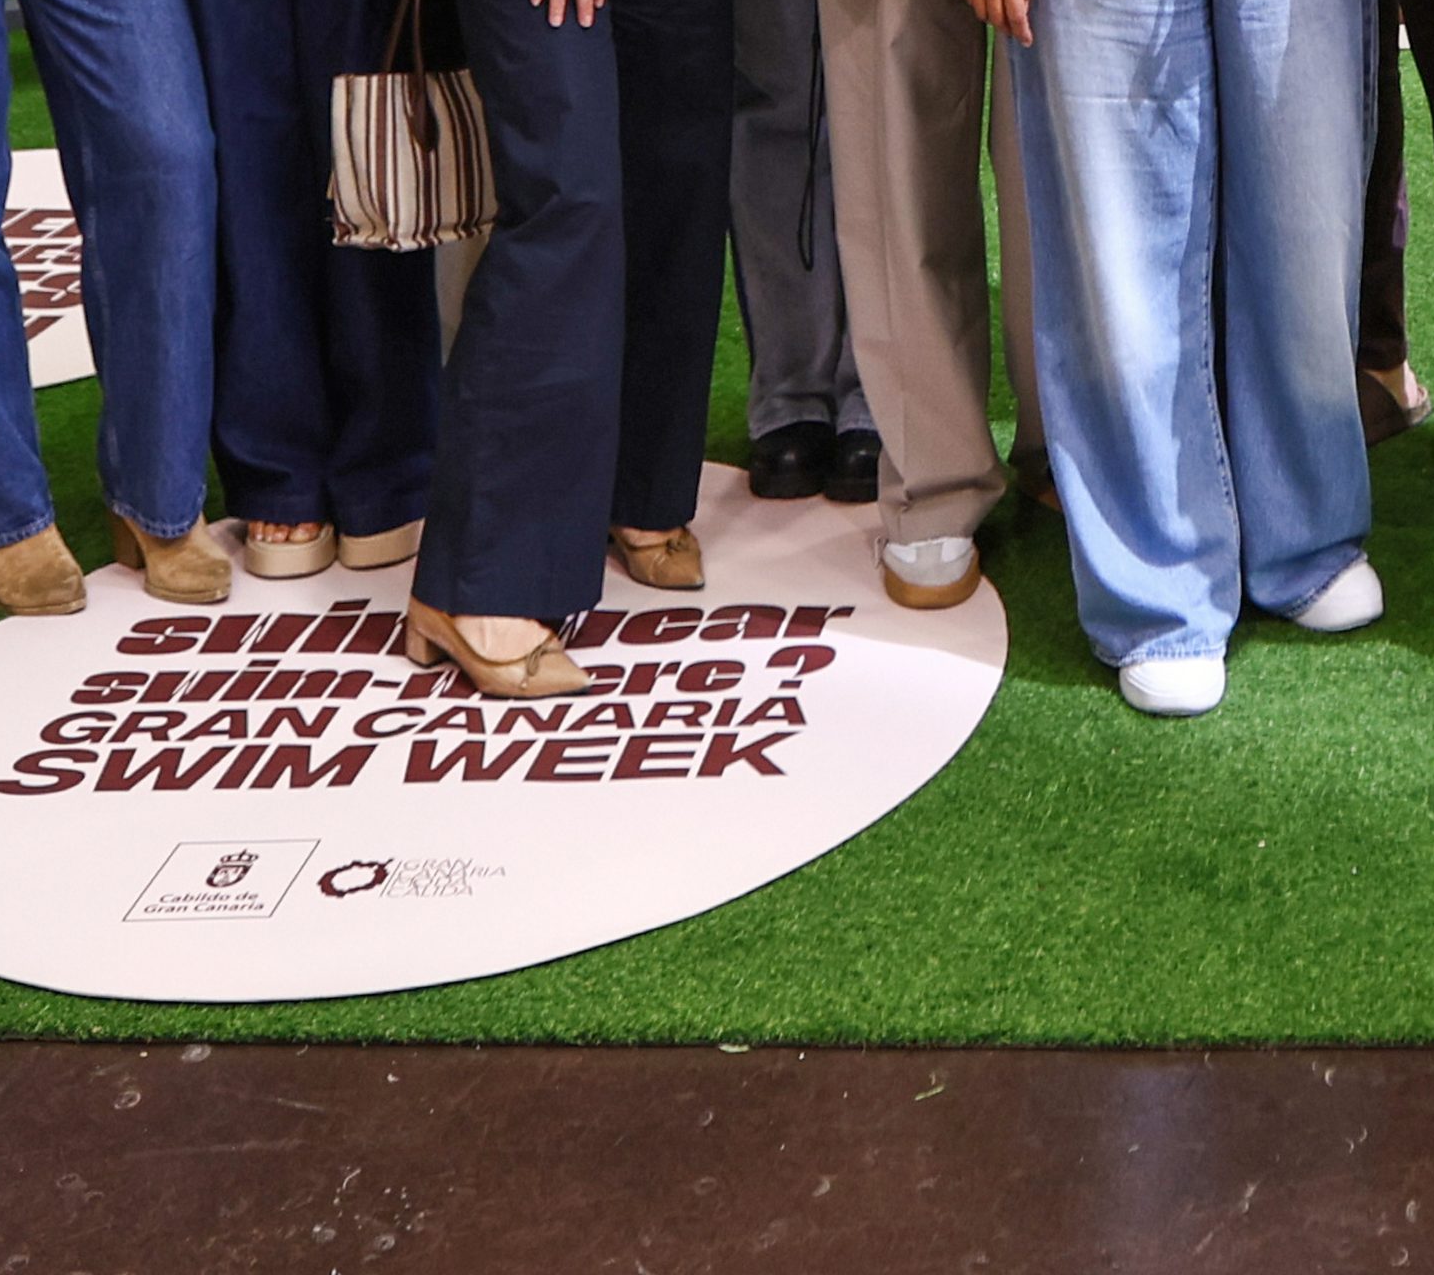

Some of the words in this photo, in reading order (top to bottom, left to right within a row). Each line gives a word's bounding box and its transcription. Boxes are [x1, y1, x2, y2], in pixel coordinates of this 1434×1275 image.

[39, 706, 340, 745] GRAN
[352, 696, 808, 738] CANARIA
[403, 730, 802, 784] WEEK
[144, 903, 189, 913] Gran
[193, 901, 264, 912] Canaria
[159, 891, 231, 904] Cabildo
[235, 891, 259, 901] de
